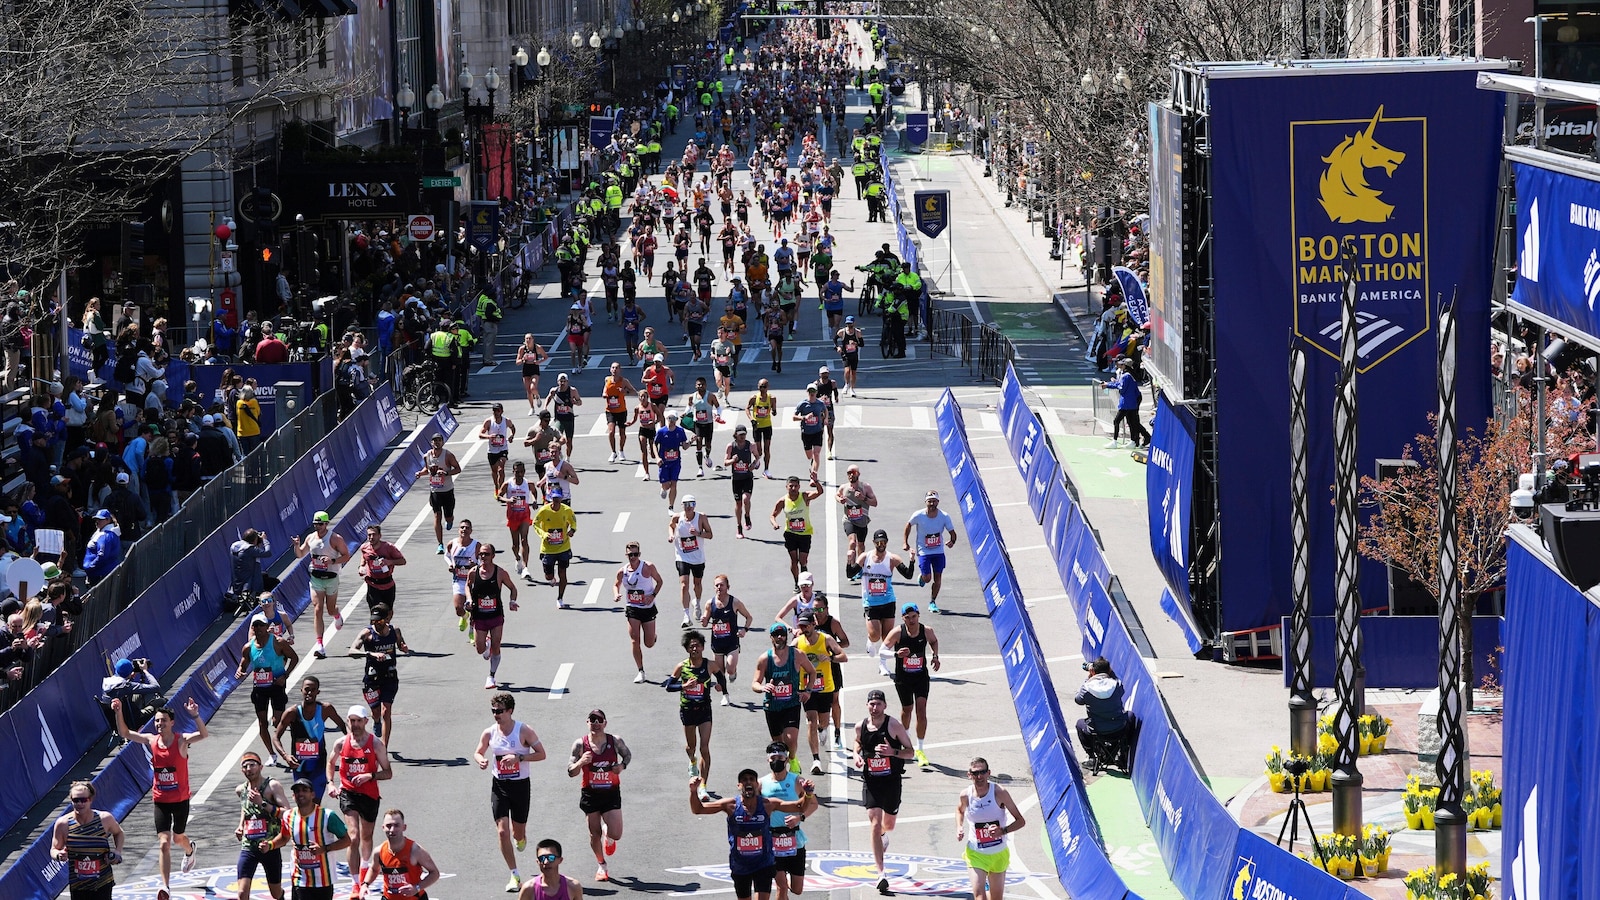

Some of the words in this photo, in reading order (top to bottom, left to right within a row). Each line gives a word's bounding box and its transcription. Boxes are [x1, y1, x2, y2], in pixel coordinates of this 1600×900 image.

[1517, 120, 1593, 139] Cpital
[431, 179, 453, 187] EXETER
[328, 183, 397, 197] LENOX
[348, 200, 377, 208] HOTEL
[1299, 233, 1420, 261] BOSTON
[1301, 293, 1336, 304] BANK
[1360, 290, 1421, 302] AMERICA
[299, 743, 315, 751] 2708
[349, 764, 365, 773] 3842
[158, 773, 174, 782] 4028
[593, 772, 609, 780] 7412
[740, 837, 759, 846] 6340
[775, 837, 792, 847] 4466
[78, 861, 96, 871] 5274
